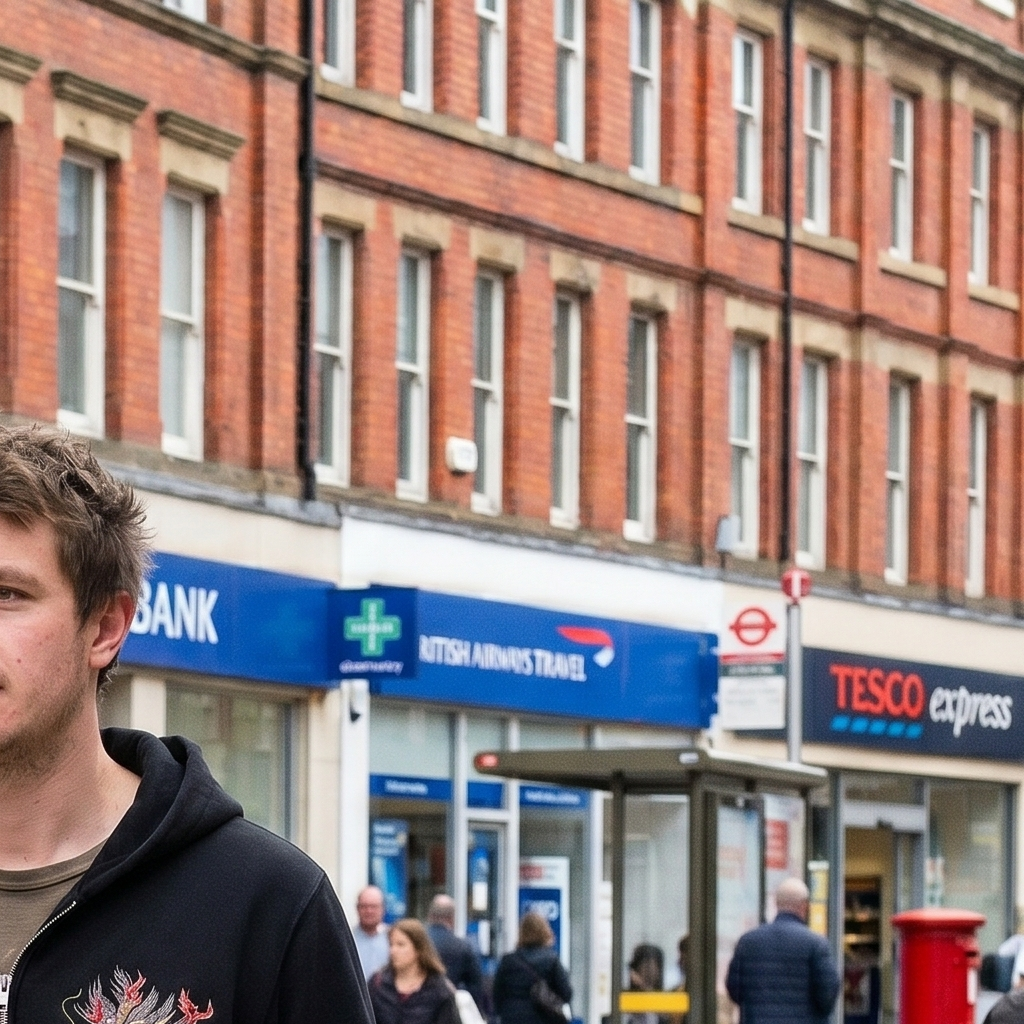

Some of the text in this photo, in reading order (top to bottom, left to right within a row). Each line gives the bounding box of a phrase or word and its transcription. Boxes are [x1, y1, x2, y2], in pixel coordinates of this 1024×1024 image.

[130, 580, 219, 645] BANK
[829, 662, 1014, 738] TESCO express
